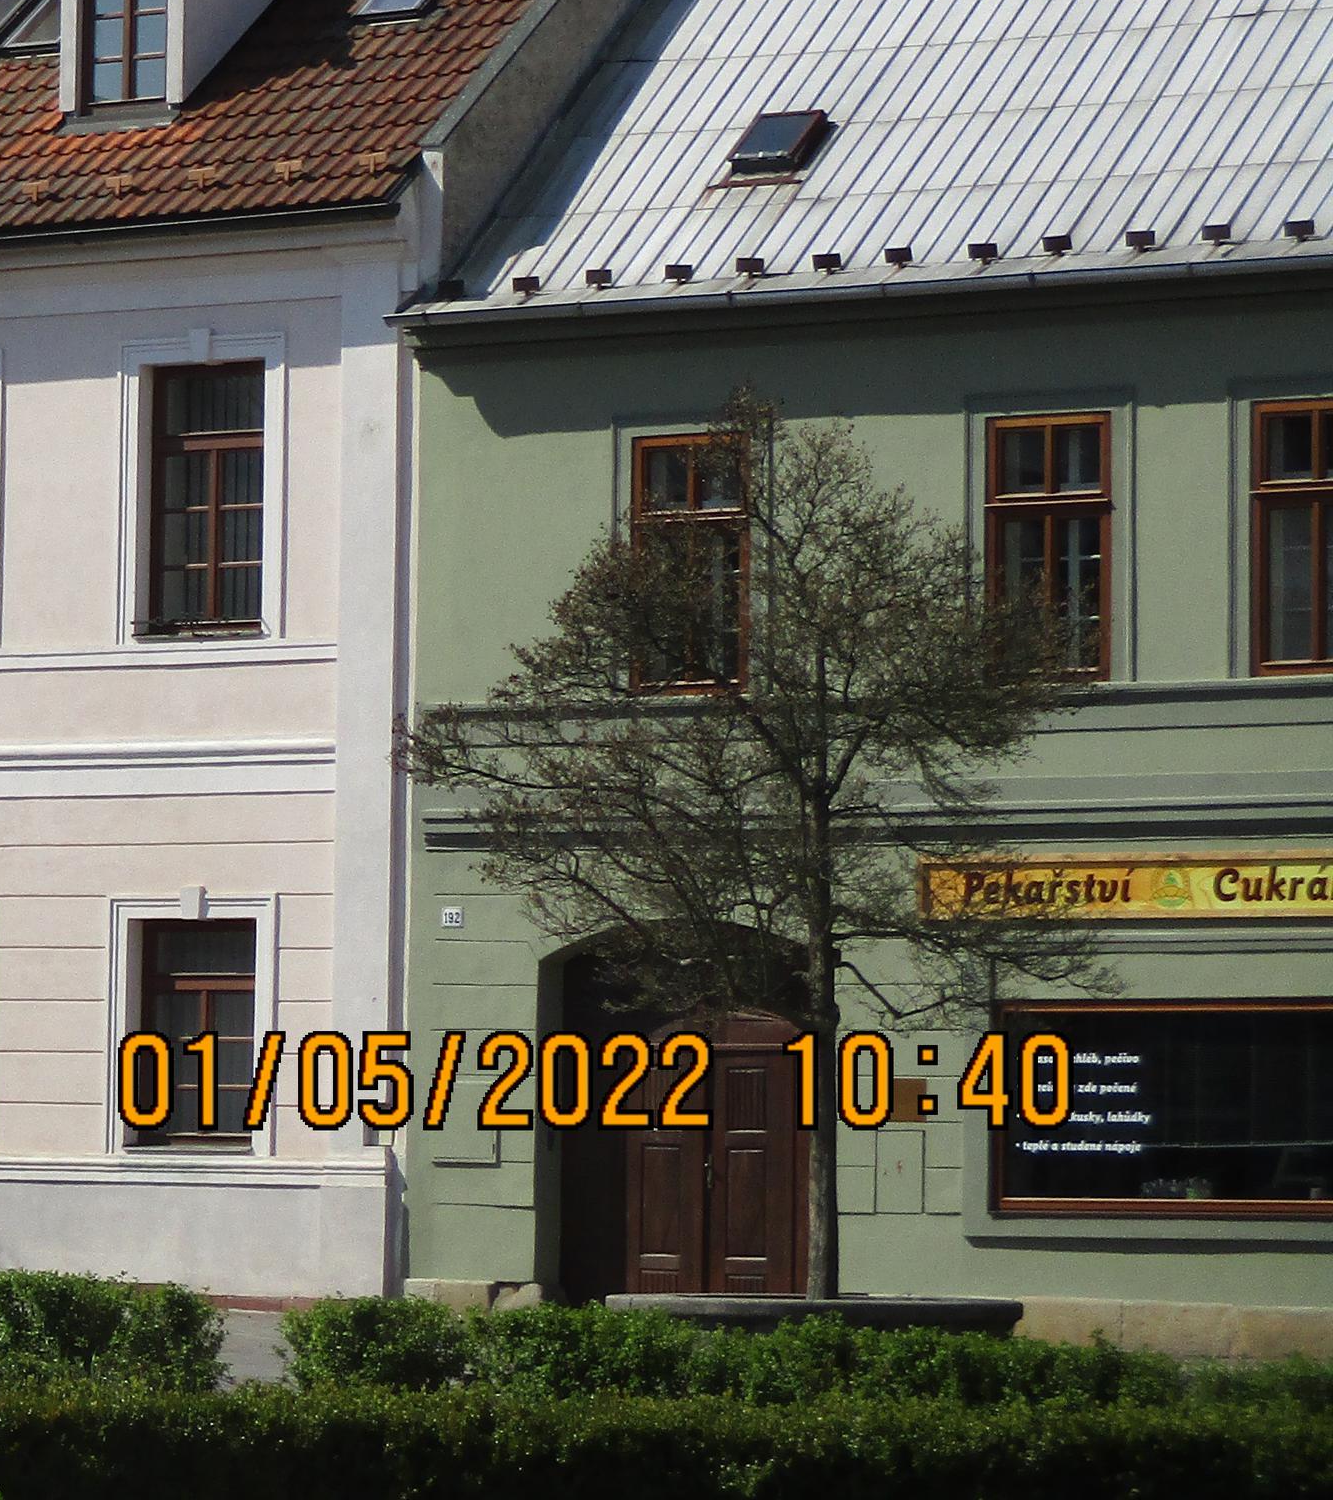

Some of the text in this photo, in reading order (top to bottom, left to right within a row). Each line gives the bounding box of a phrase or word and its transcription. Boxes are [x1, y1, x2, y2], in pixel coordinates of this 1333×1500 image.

[963, 865, 1333, 904] Pekařství Cukrá
[444, 911, 460, 924] 192
[1103, 1052, 1141, 1065] pečivo
[1077, 1081, 1138, 1096] zde pečené
[1068, 1110, 1152, 1125] kusky, lahůdky
[1022, 1140, 1142, 1154] teplé a studené nápoje
